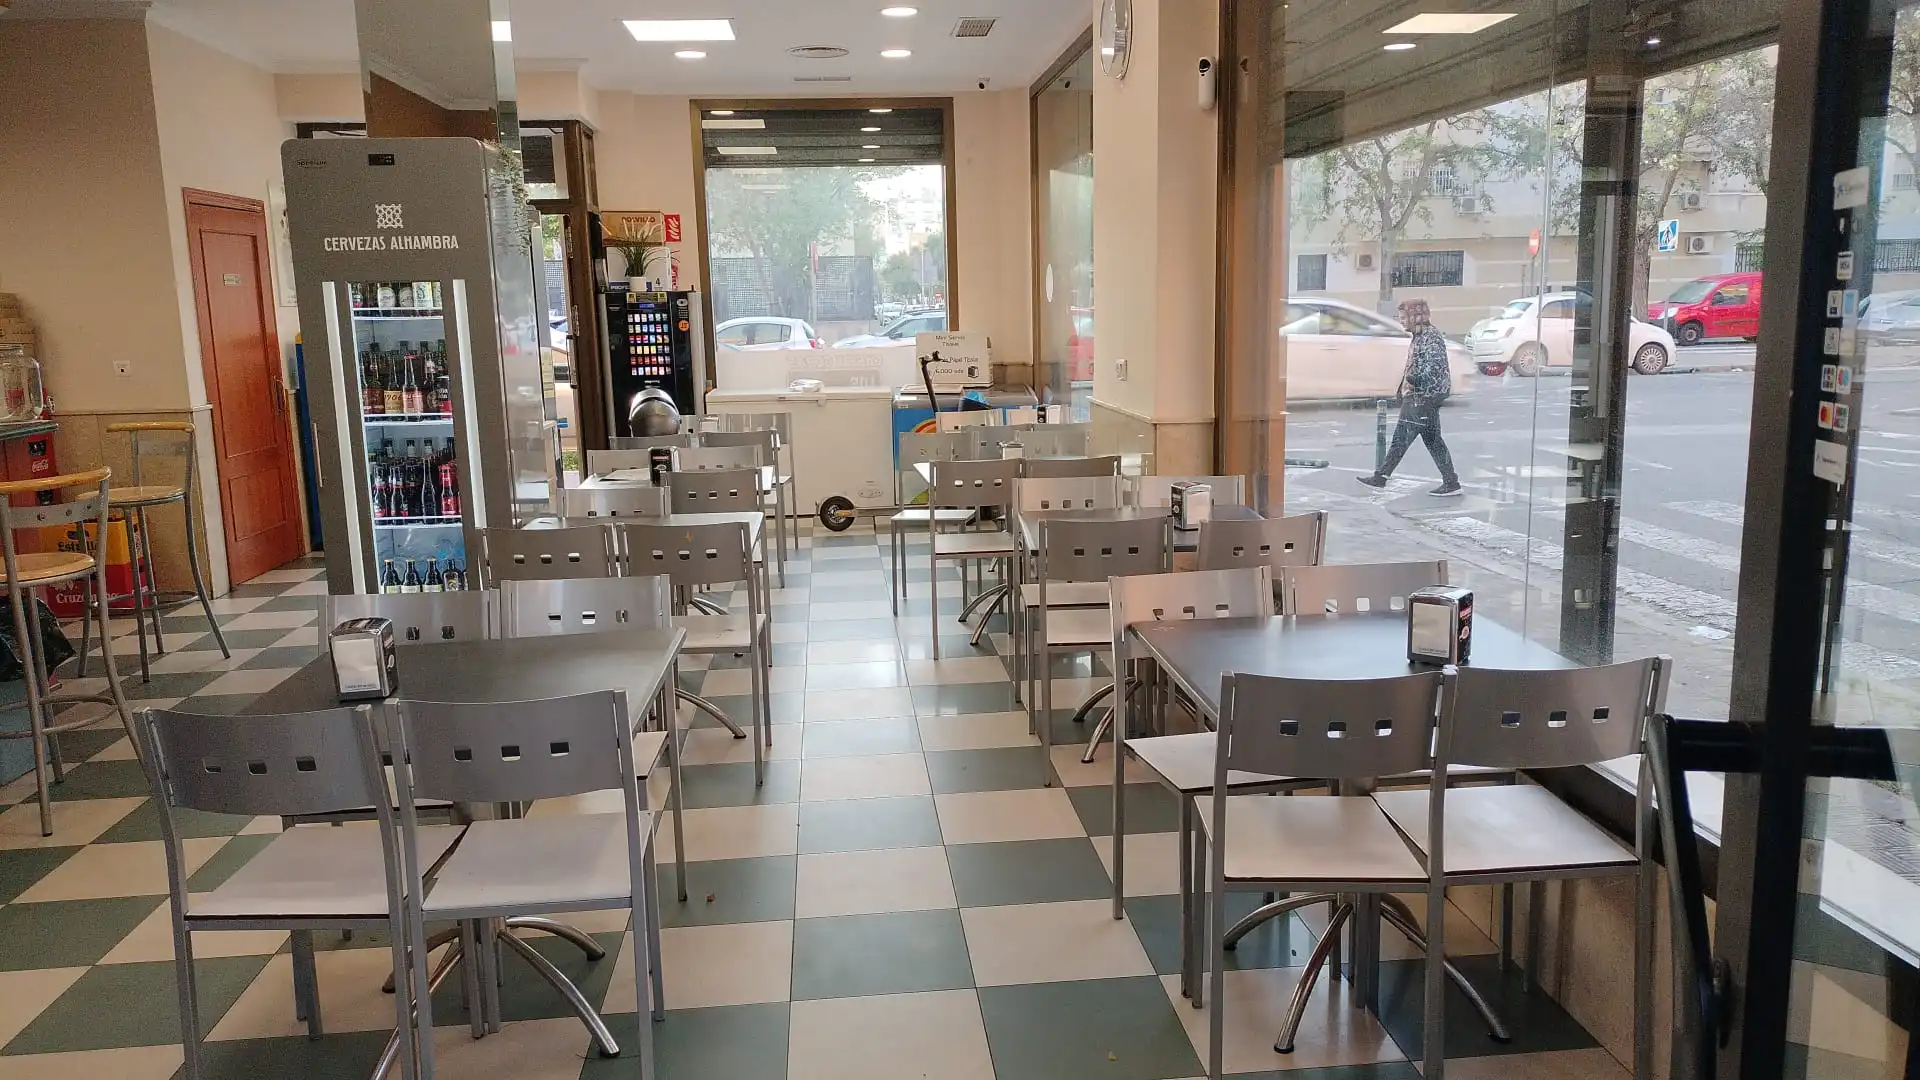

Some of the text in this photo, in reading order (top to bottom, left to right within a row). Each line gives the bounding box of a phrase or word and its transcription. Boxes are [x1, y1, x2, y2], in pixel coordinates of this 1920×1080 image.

[324, 235, 459, 251] CERVEZAS ALHAMBRA
[58, 541, 97, 551] Estrll
